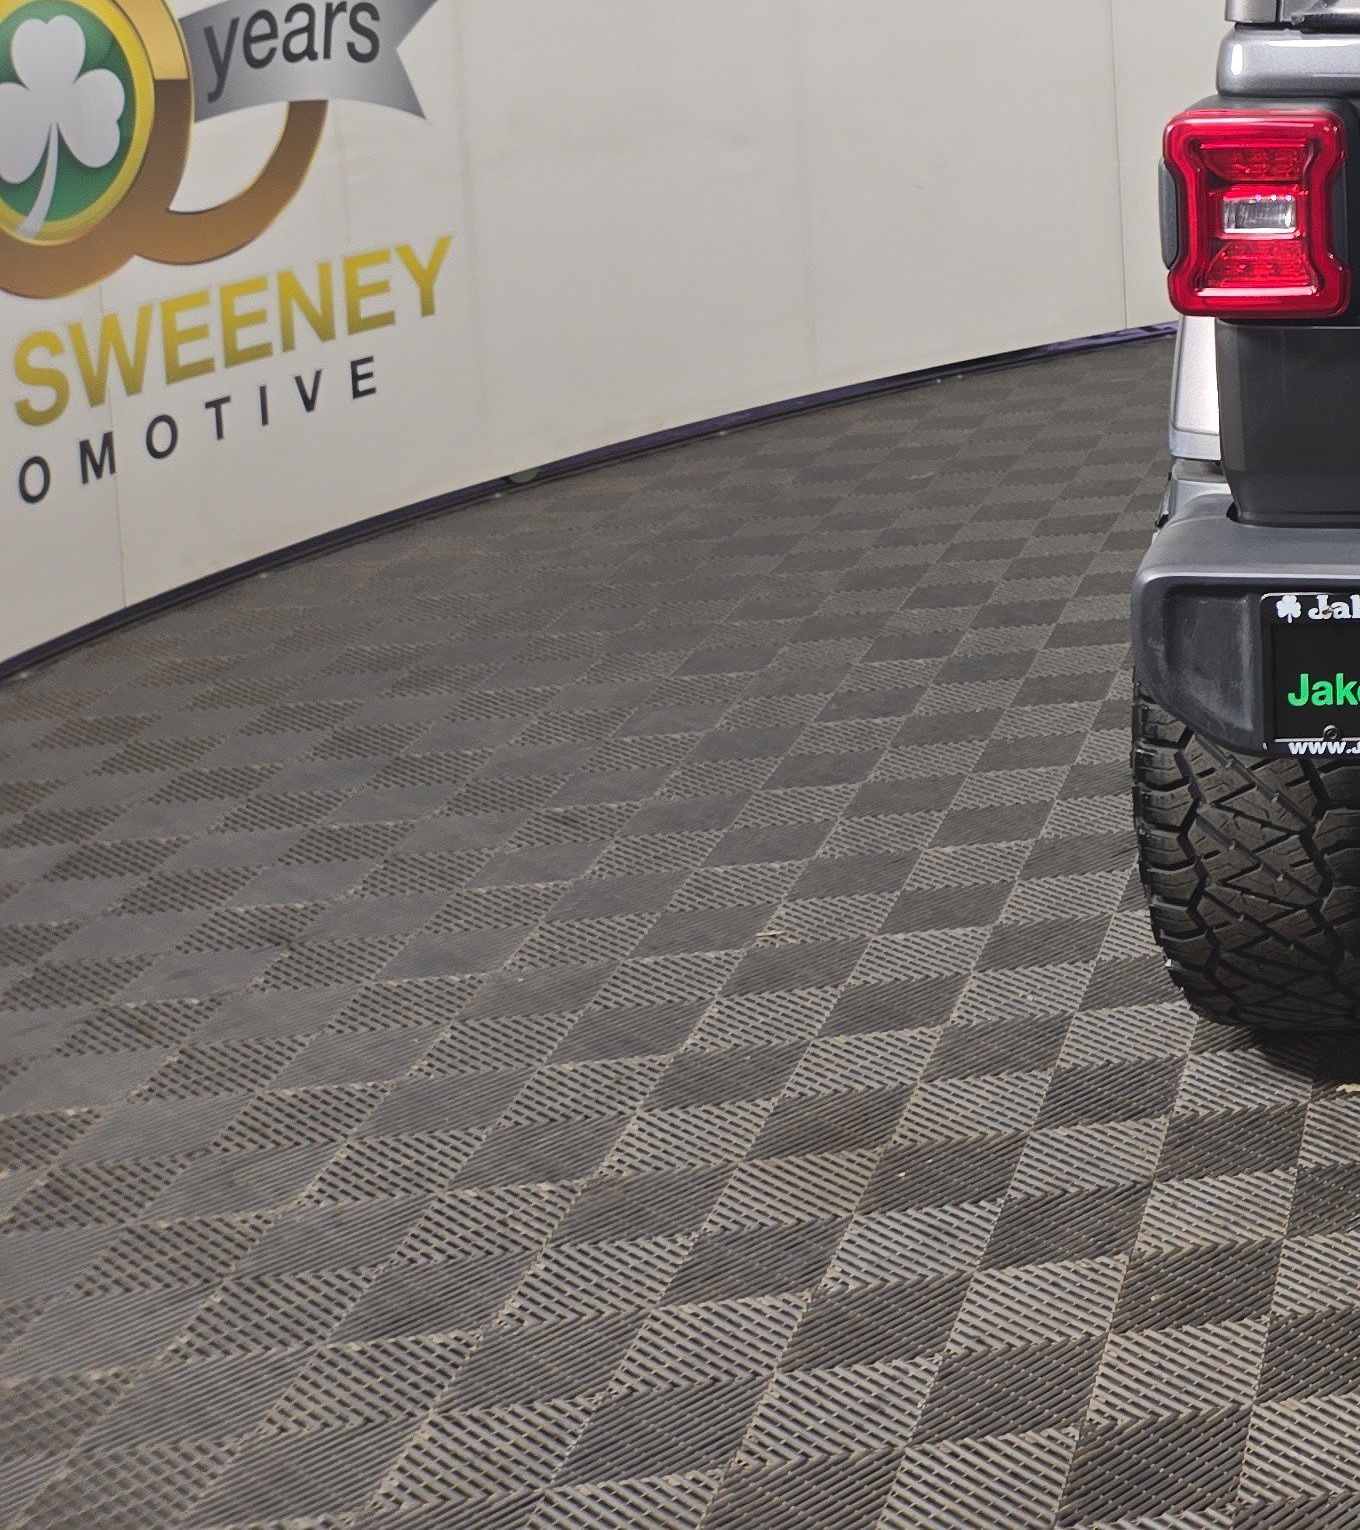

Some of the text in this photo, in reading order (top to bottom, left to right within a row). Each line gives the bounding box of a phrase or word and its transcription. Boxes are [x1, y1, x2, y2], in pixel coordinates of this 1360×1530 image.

[203, 1, 381, 104] years
[14, 236, 453, 427] SWEENEY
[18, 356, 377, 504] OMOTIVE
